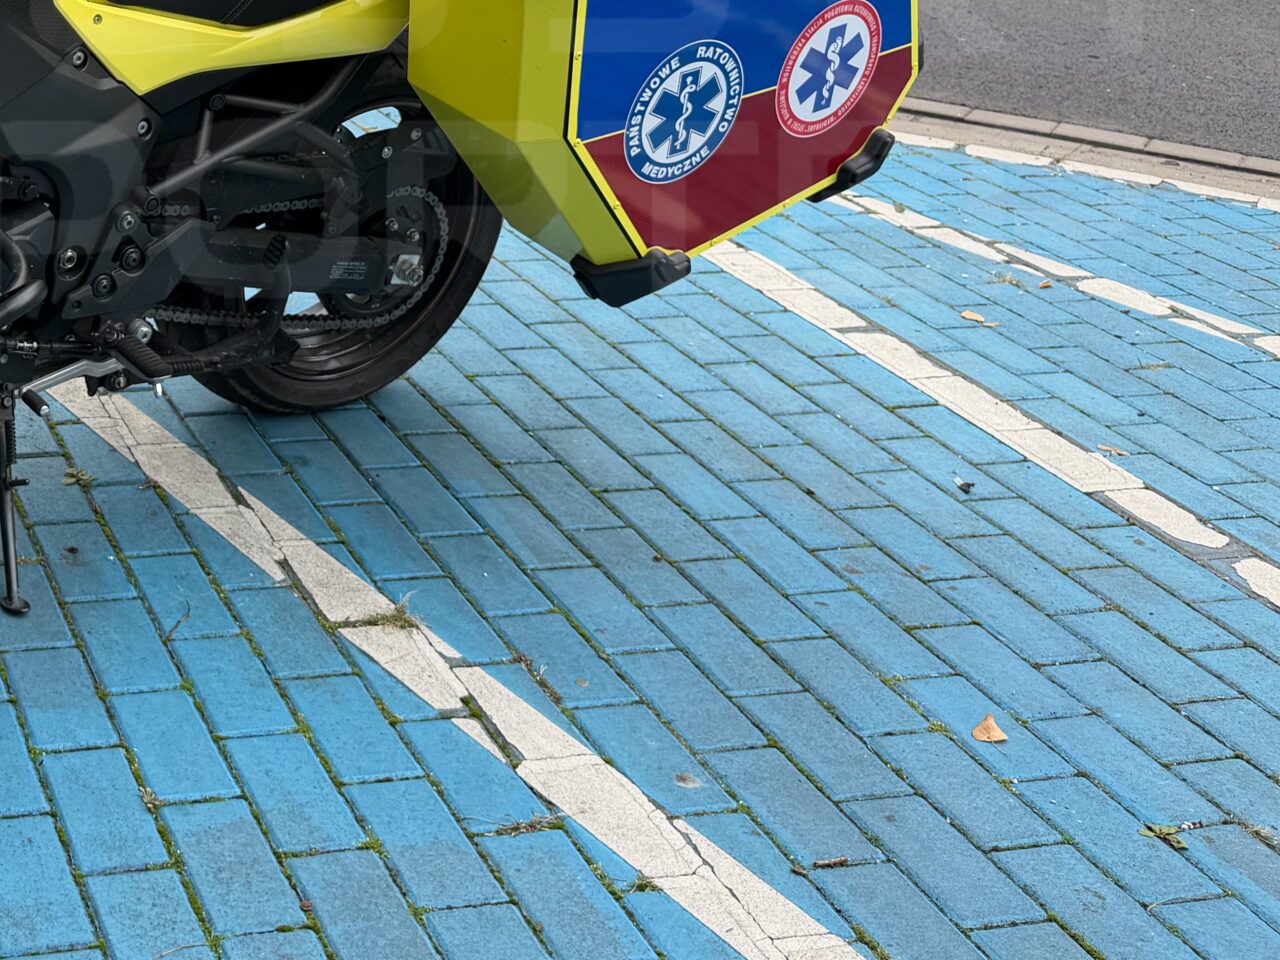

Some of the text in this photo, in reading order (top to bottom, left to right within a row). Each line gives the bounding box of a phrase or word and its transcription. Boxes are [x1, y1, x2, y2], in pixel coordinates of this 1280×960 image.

[804, 15, 823, 39] STACJA
[627, 46, 741, 179] PAŃSTWOWE RATOWNICTWO MEDYCZNE
